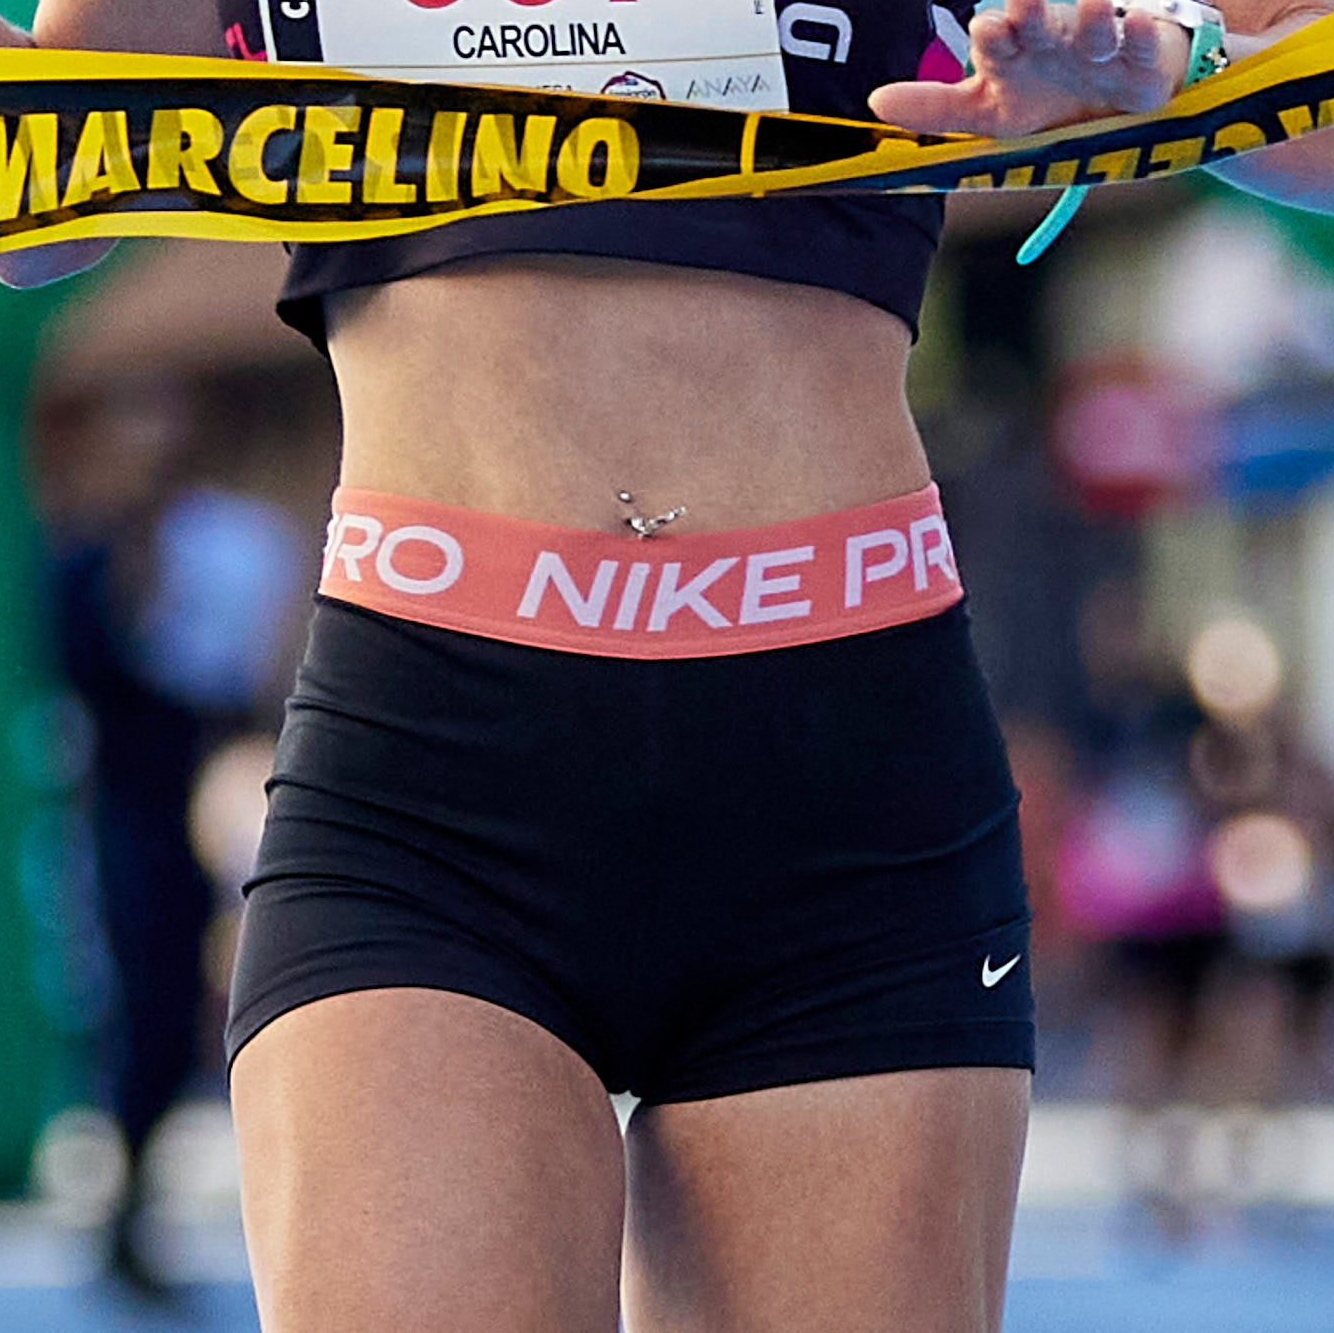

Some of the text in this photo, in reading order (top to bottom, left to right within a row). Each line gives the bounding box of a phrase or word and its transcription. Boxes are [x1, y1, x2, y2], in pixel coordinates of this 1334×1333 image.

[453, 22, 626, 59] CAROLINA
[686, 74, 771, 100] ANAYA
[517, 546, 815, 633] NIKE
